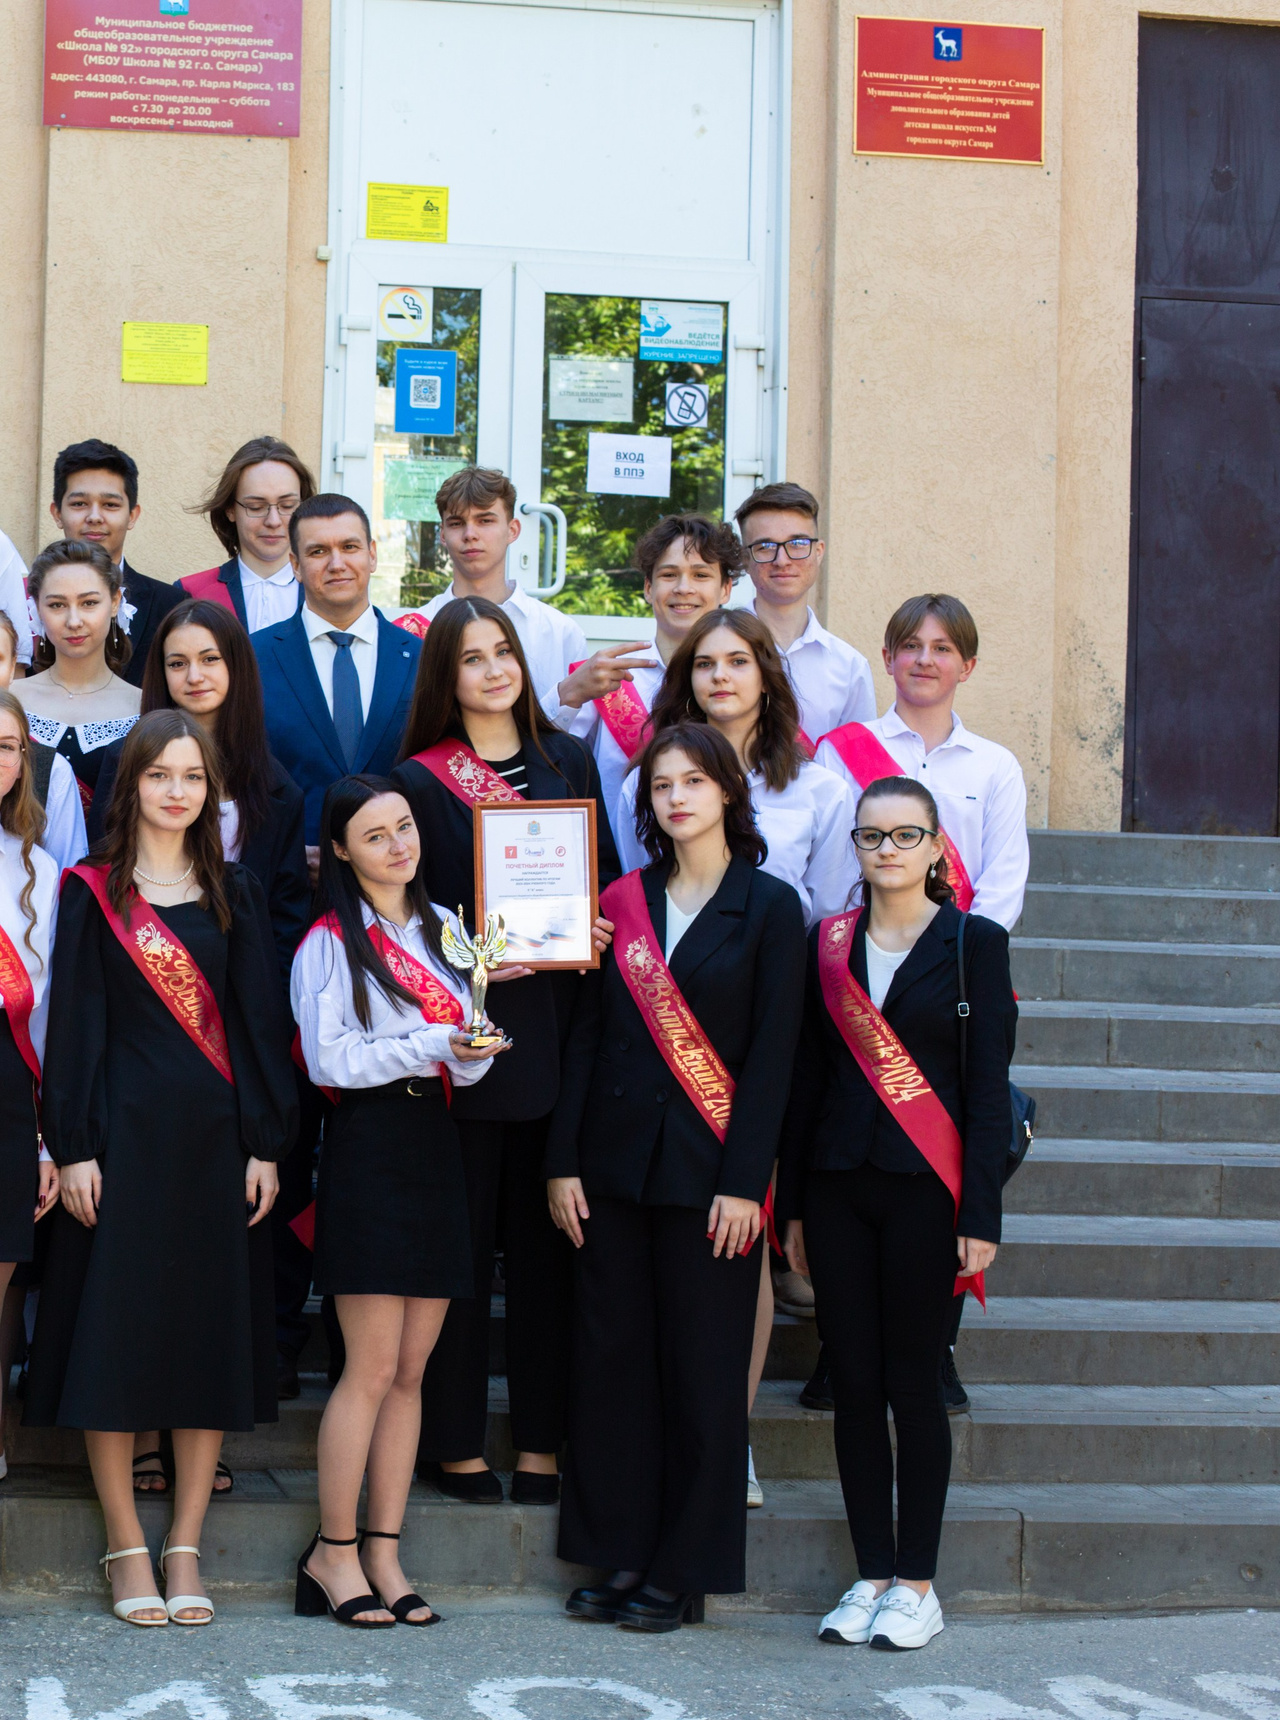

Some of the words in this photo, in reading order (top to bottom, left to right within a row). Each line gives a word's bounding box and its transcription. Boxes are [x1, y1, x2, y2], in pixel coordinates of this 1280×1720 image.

[95, 16, 185, 30] Муниципальное
[188, 20, 253, 33] бюджетное
[74, 28, 201, 45] общеобразовательное
[204, 36, 274, 48] учреждение
[56, 41, 102, 52] «Школа
[104, 43, 118, 53] №
[120, 44, 142, 54] 92»
[145, 47, 208, 59] городского
[211, 49, 248, 61] округа
[251, 50, 293, 62] Самара
[83, 55, 120, 66] (МБОУ
[123, 57, 160, 68] Школа
[162, 58, 176, 69] №
[178, 59, 192, 69] 92
[195, 62, 213, 71] г.о.
[216, 61, 263, 74] Самара)
[50, 73, 83, 83] адрес:
[85, 73, 127, 85] 443080,
[129, 76, 137, 85] г.
[139, 76, 180, 88] Самара,
[182, 79, 197, 89] пр.
[199, 79, 231, 90] Карла
[233, 81, 273, 92] Маркса,
[276, 82, 295, 92] 183
[861, 69, 929, 83] Администрация
[931, 74, 976, 86] городского
[978, 77, 1007, 88] округа
[1008, 79, 1040, 90] Самара
[74, 90, 108, 101] режим
[110, 91, 151, 102] работы:
[153, 94, 220, 105] понедельник
[229, 96, 270, 107] суббота
[867, 87, 921, 99] Муниципальное
[994, 96, 1034, 107] учреждение
[140, 104, 163, 114] 7.30
[167, 107, 181, 116] до
[182, 105, 212, 116] 20.00
[890, 105, 948, 116] дополнительного
[949, 107, 990, 119] образования
[991, 110, 1010, 120] детей
[110, 115, 174, 126] воскресенье
[183, 118, 233, 129] выходной
[904, 120, 930, 130] детская
[931, 122, 953, 132] школа
[954, 123, 984, 134] искусств
[906, 135, 943, 146] городского
[944, 138, 967, 148] округа
[968, 139, 994, 149] Самара
[644, 338, 720, 348] ВИДЕОНАБЛЮДЕНИЕ
[688, 332, 720, 341] ВЕДЁТСЯ
[643, 351, 674, 359] КУРЕНИЕ
[678, 353, 720, 361] ЗАПРЕЩЕНО
[615, 451, 645, 463] ВХОД
[614, 467, 621, 477] В
[623, 467, 645, 478] ППЭ
[638, 972, 727, 1097] Выпускник
[872, 1055, 932, 1105] 2024
